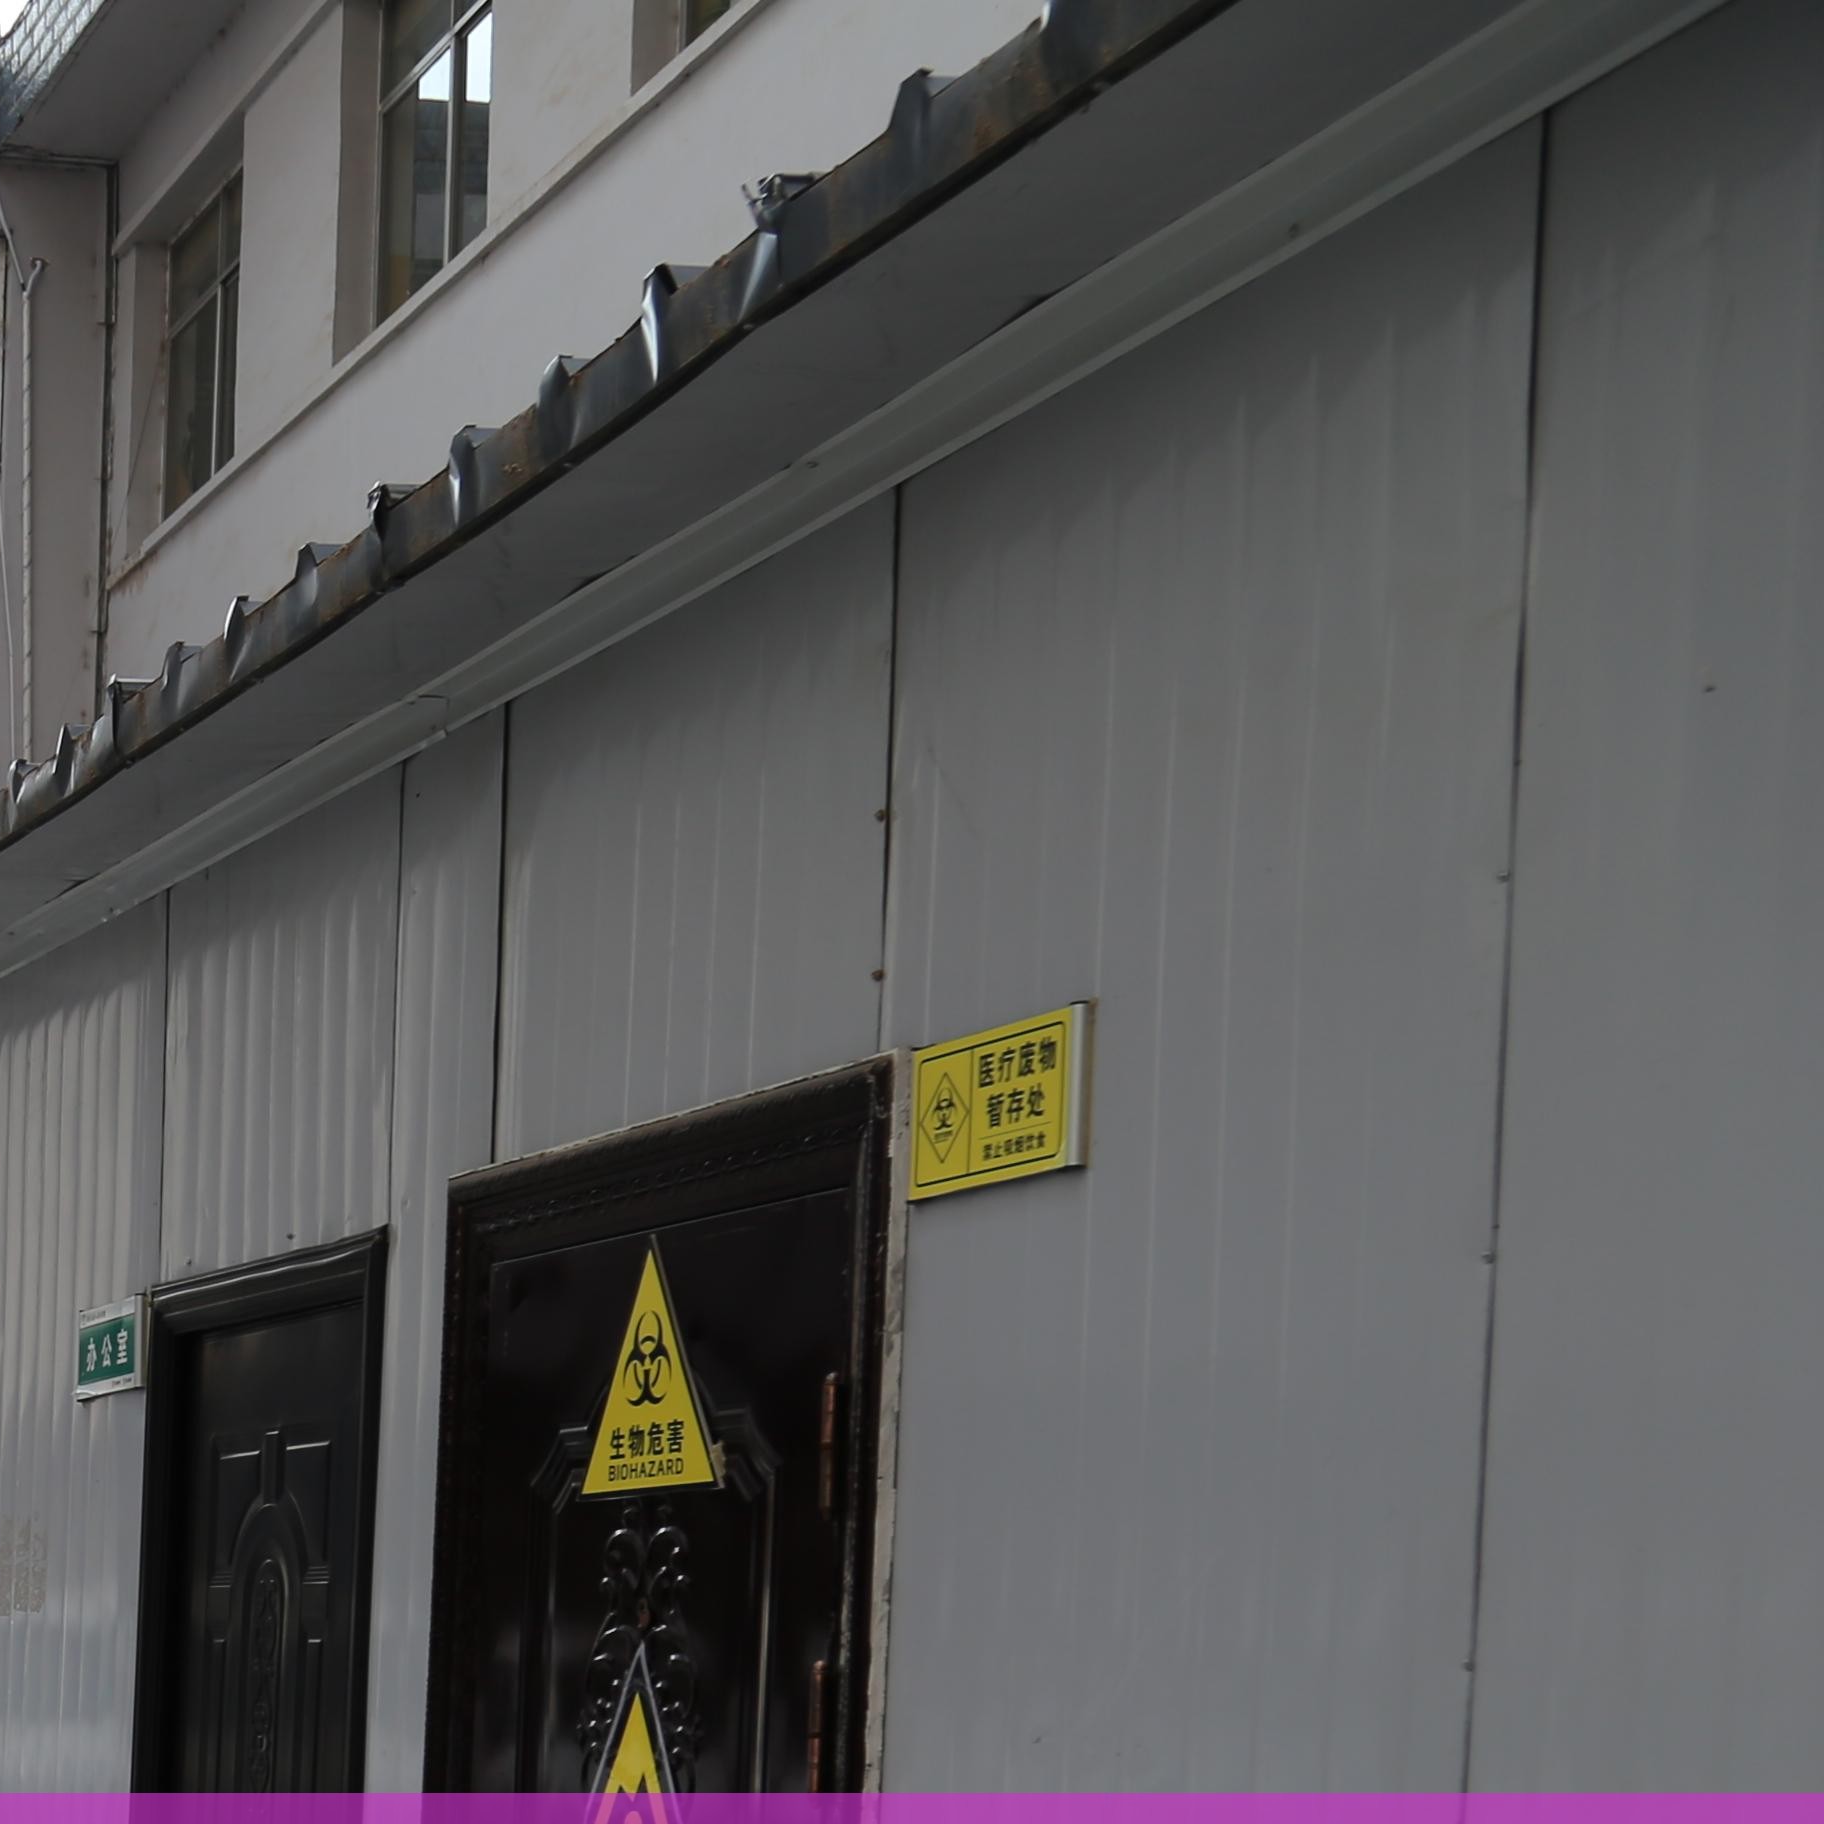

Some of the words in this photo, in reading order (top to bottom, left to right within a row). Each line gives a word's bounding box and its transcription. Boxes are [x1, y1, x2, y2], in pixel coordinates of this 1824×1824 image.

[978, 1037, 1057, 1089] 医疗废物
[987, 1083, 1045, 1128] 暂存处
[86, 1327, 129, 1372] 办公室
[609, 1419, 684, 1460] 生物危害
[608, 1458, 684, 1481] BIOHAZARD
